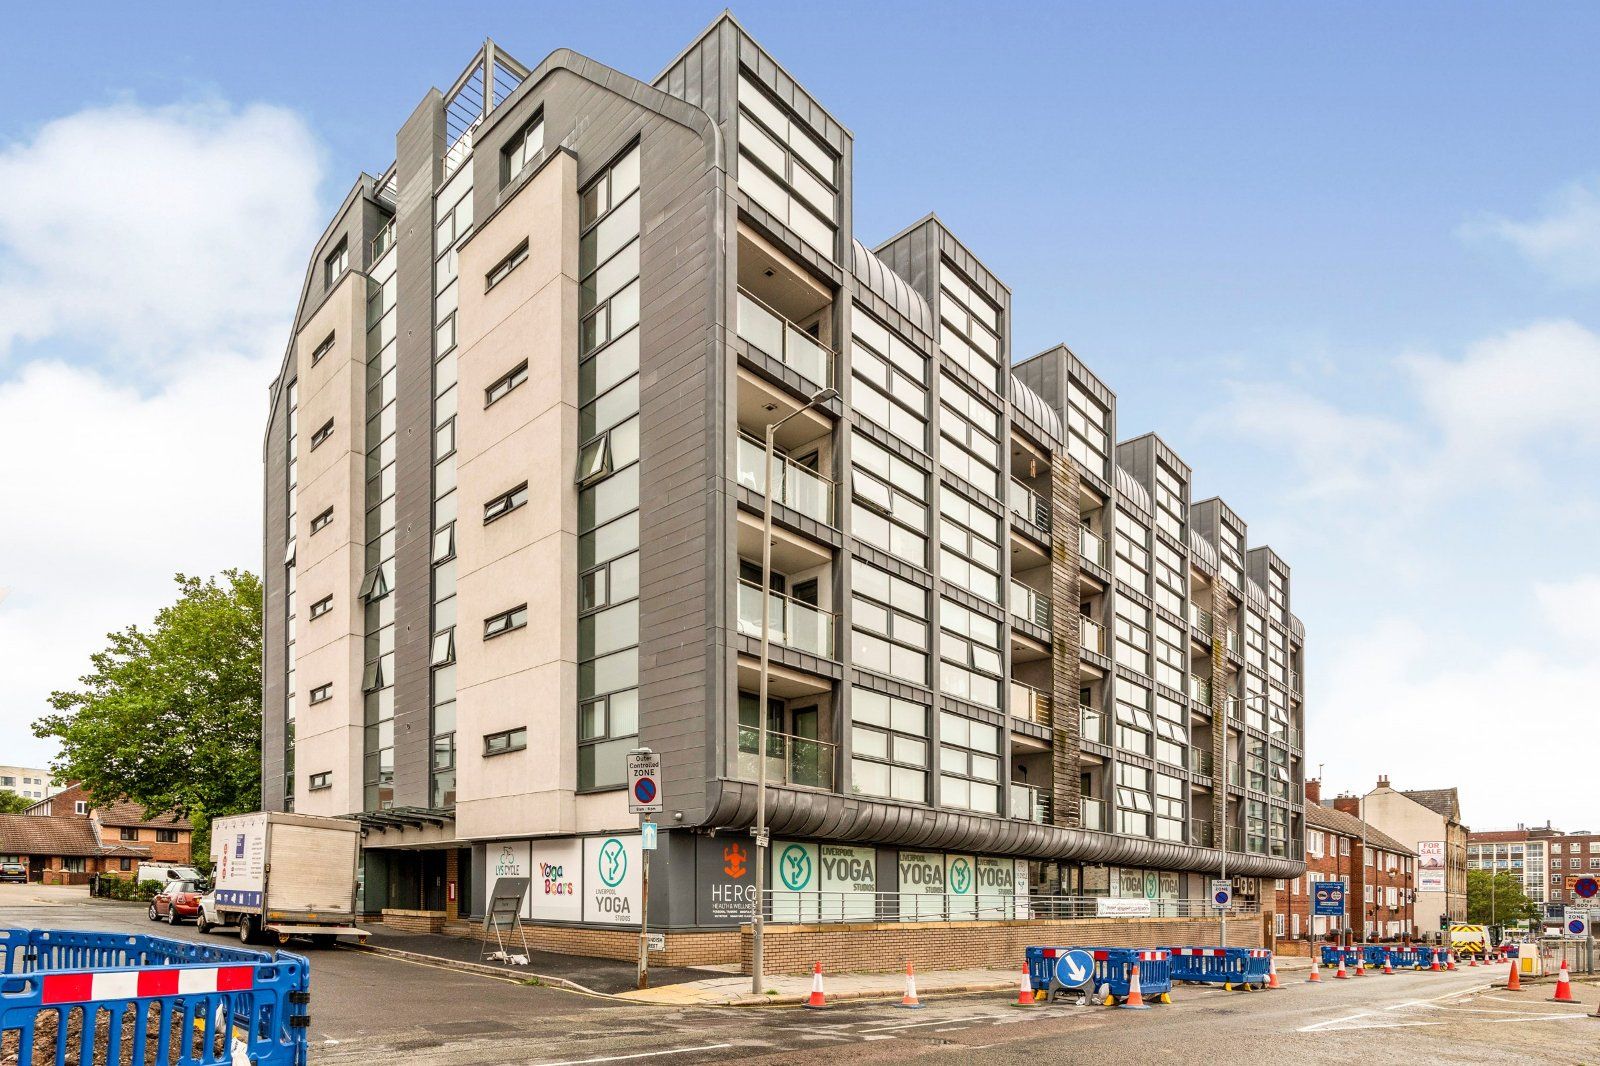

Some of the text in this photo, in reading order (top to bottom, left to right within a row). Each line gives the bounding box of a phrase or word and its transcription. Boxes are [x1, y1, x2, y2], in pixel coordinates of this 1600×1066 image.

[634, 768, 655, 776] ZONE
[822, 847, 855, 857] LIVERPOOL
[900, 853, 927, 863] LIVERPOOL
[822, 857, 875, 882] YOGA
[978, 858, 999, 867] LIVERPOOL
[539, 861, 563, 882] Yoga
[900, 863, 943, 886] YOGA
[978, 867, 1013, 888] YOGA
[544, 879, 574, 895] Bears
[853, 883, 875, 892] STUDIOS
[925, 886, 943, 894] STUDIOS
[1121, 877, 1142, 892] YOGA
[1160, 879, 1179, 893] YOGA
[712, 884, 757, 902] HERO
[595, 896, 631, 914] YOGA
[615, 914, 631, 922] STUDIOS
